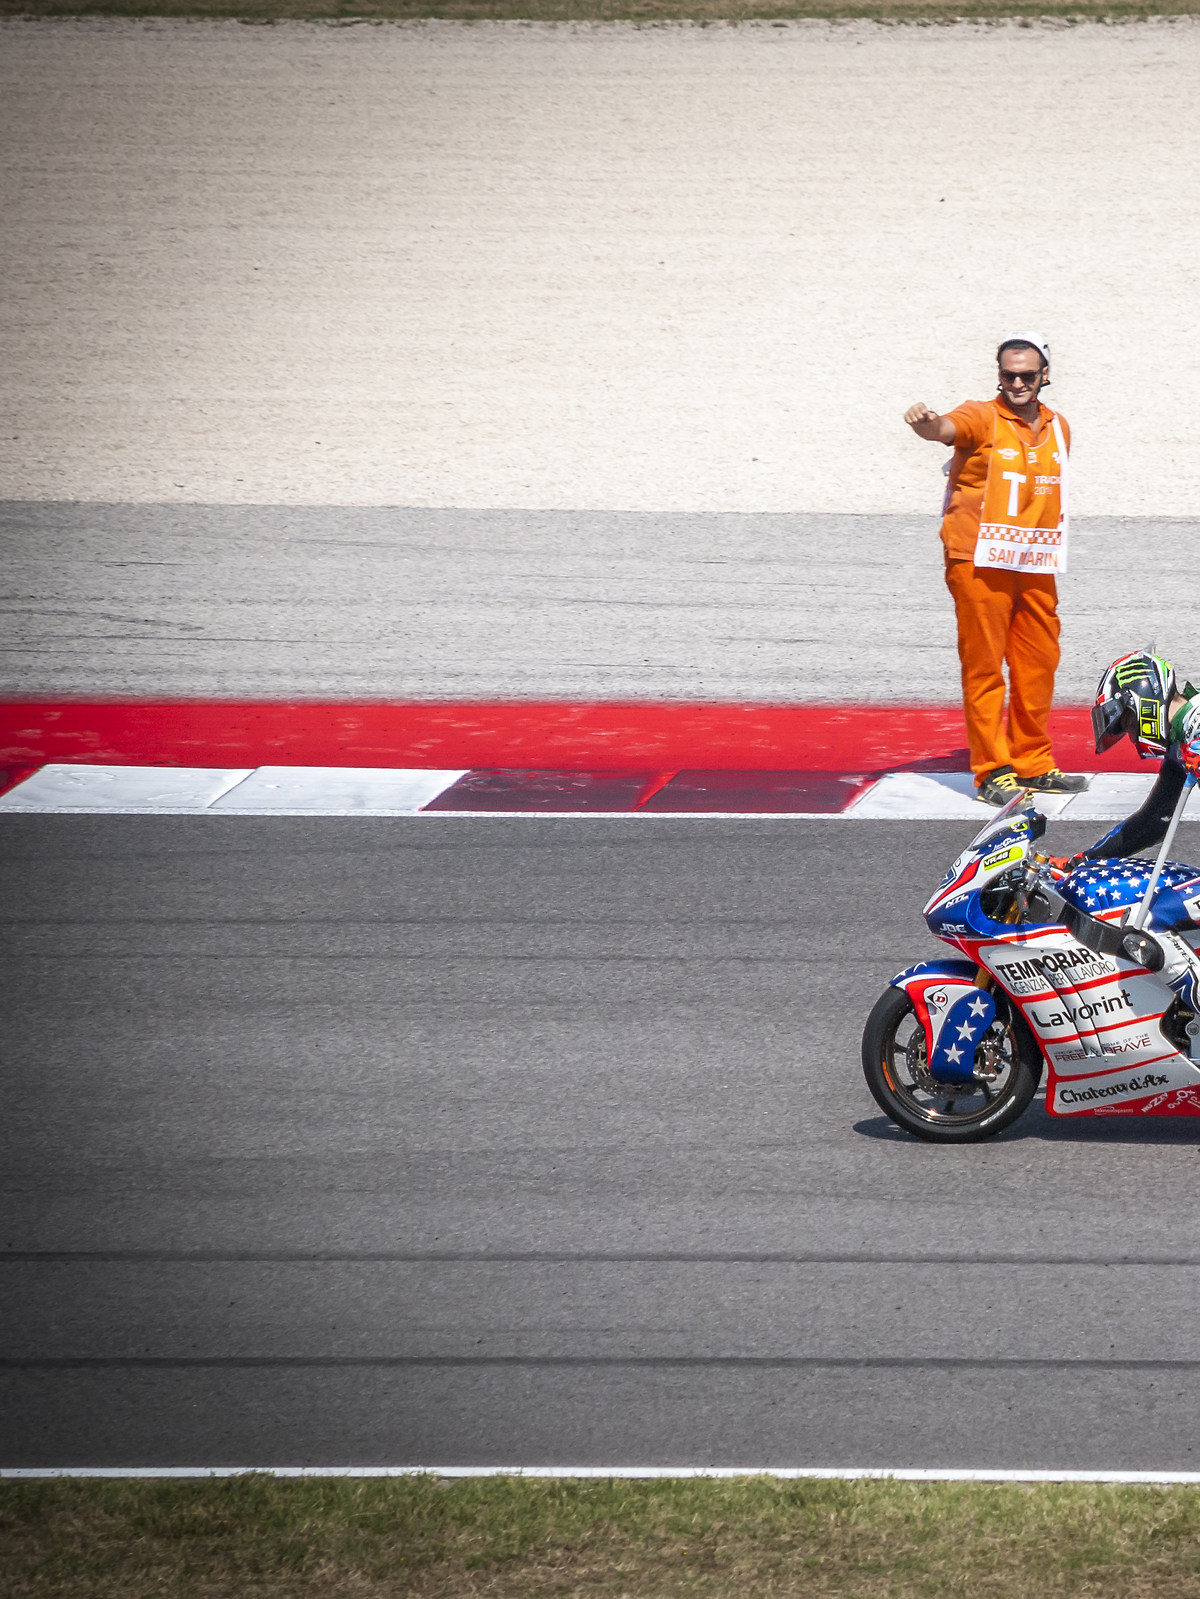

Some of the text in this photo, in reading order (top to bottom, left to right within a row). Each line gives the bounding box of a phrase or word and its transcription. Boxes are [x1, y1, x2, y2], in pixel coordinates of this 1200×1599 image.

[988, 547, 1016, 565] SAN
[1009, 977, 1049, 994] AGENZIA
[1074, 960, 1116, 981] LAVORO
[1031, 989, 1134, 1028] Lavorint
[1054, 1052, 1087, 1062] FREE
[1104, 1037, 1152, 1055] BRAVE
[1060, 1083, 1128, 1104] Chateau
